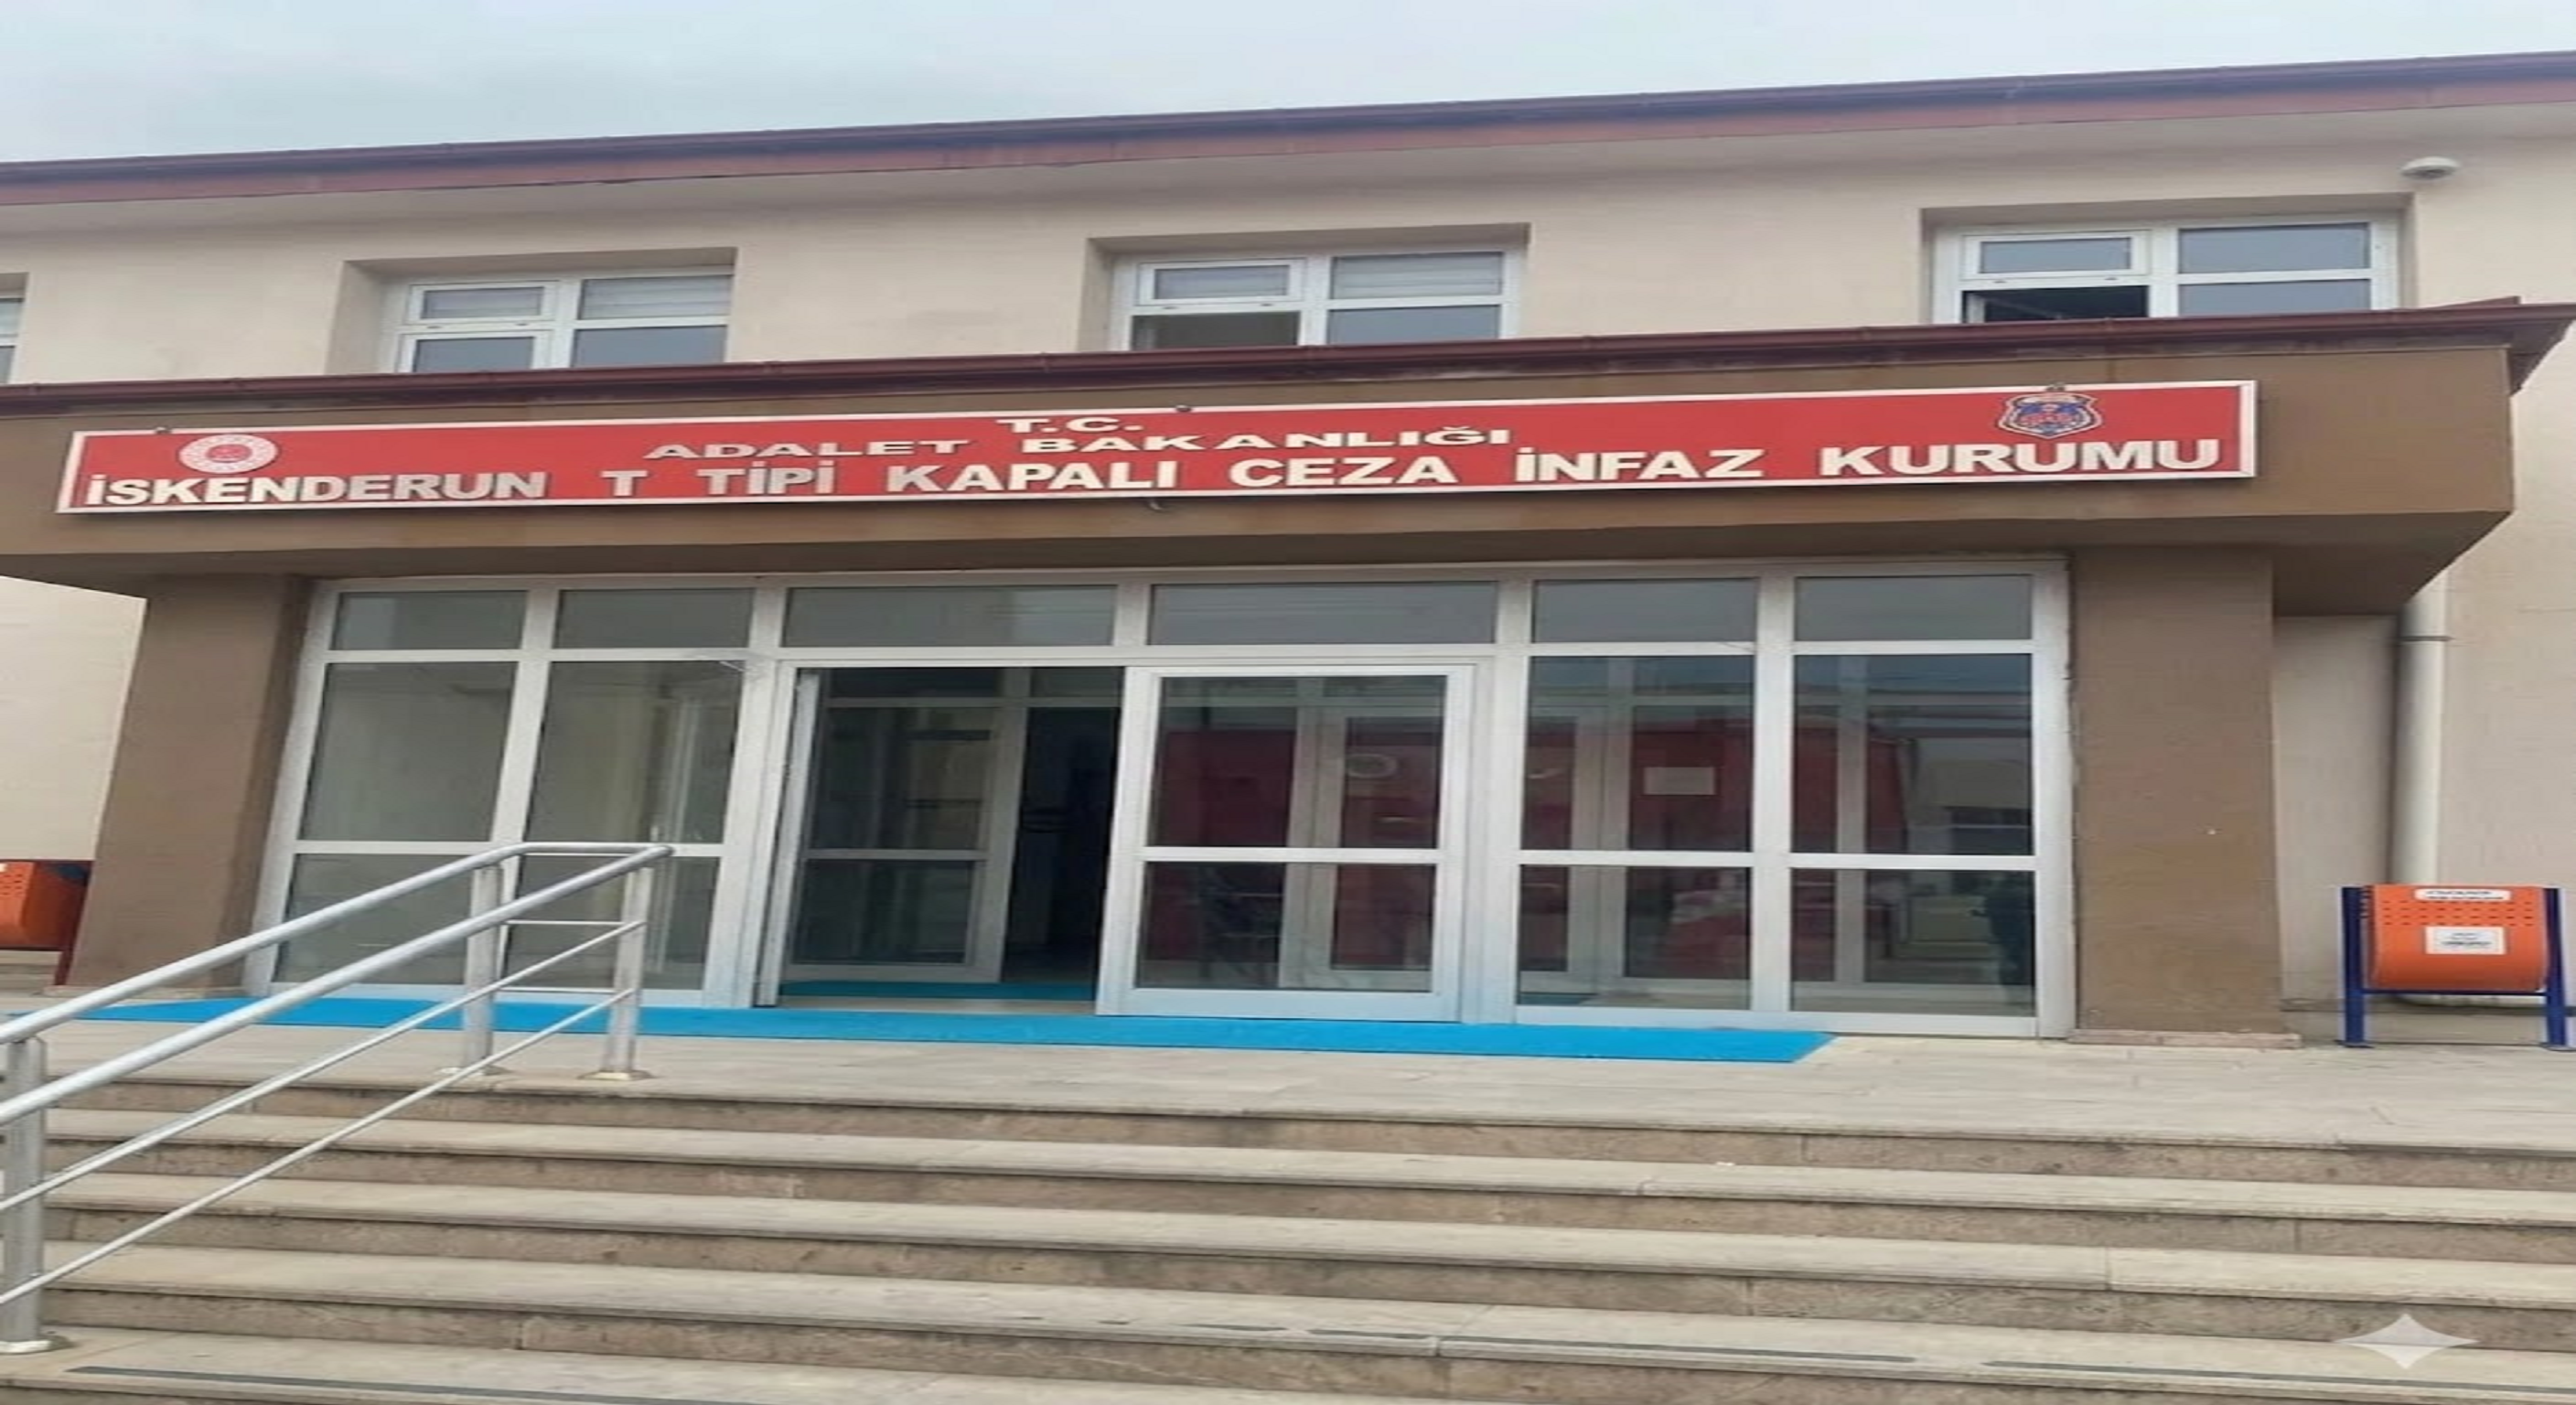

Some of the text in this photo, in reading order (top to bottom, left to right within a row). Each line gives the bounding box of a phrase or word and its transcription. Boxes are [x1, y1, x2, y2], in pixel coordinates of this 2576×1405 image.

[995, 417, 1143, 433] T.C.
[643, 426, 1509, 459] ADALET BAKANLIĞI
[86, 439, 2219, 505] İSKENDERUN T TİPİ KAPALI CEZA İNFAZ KURUMU
